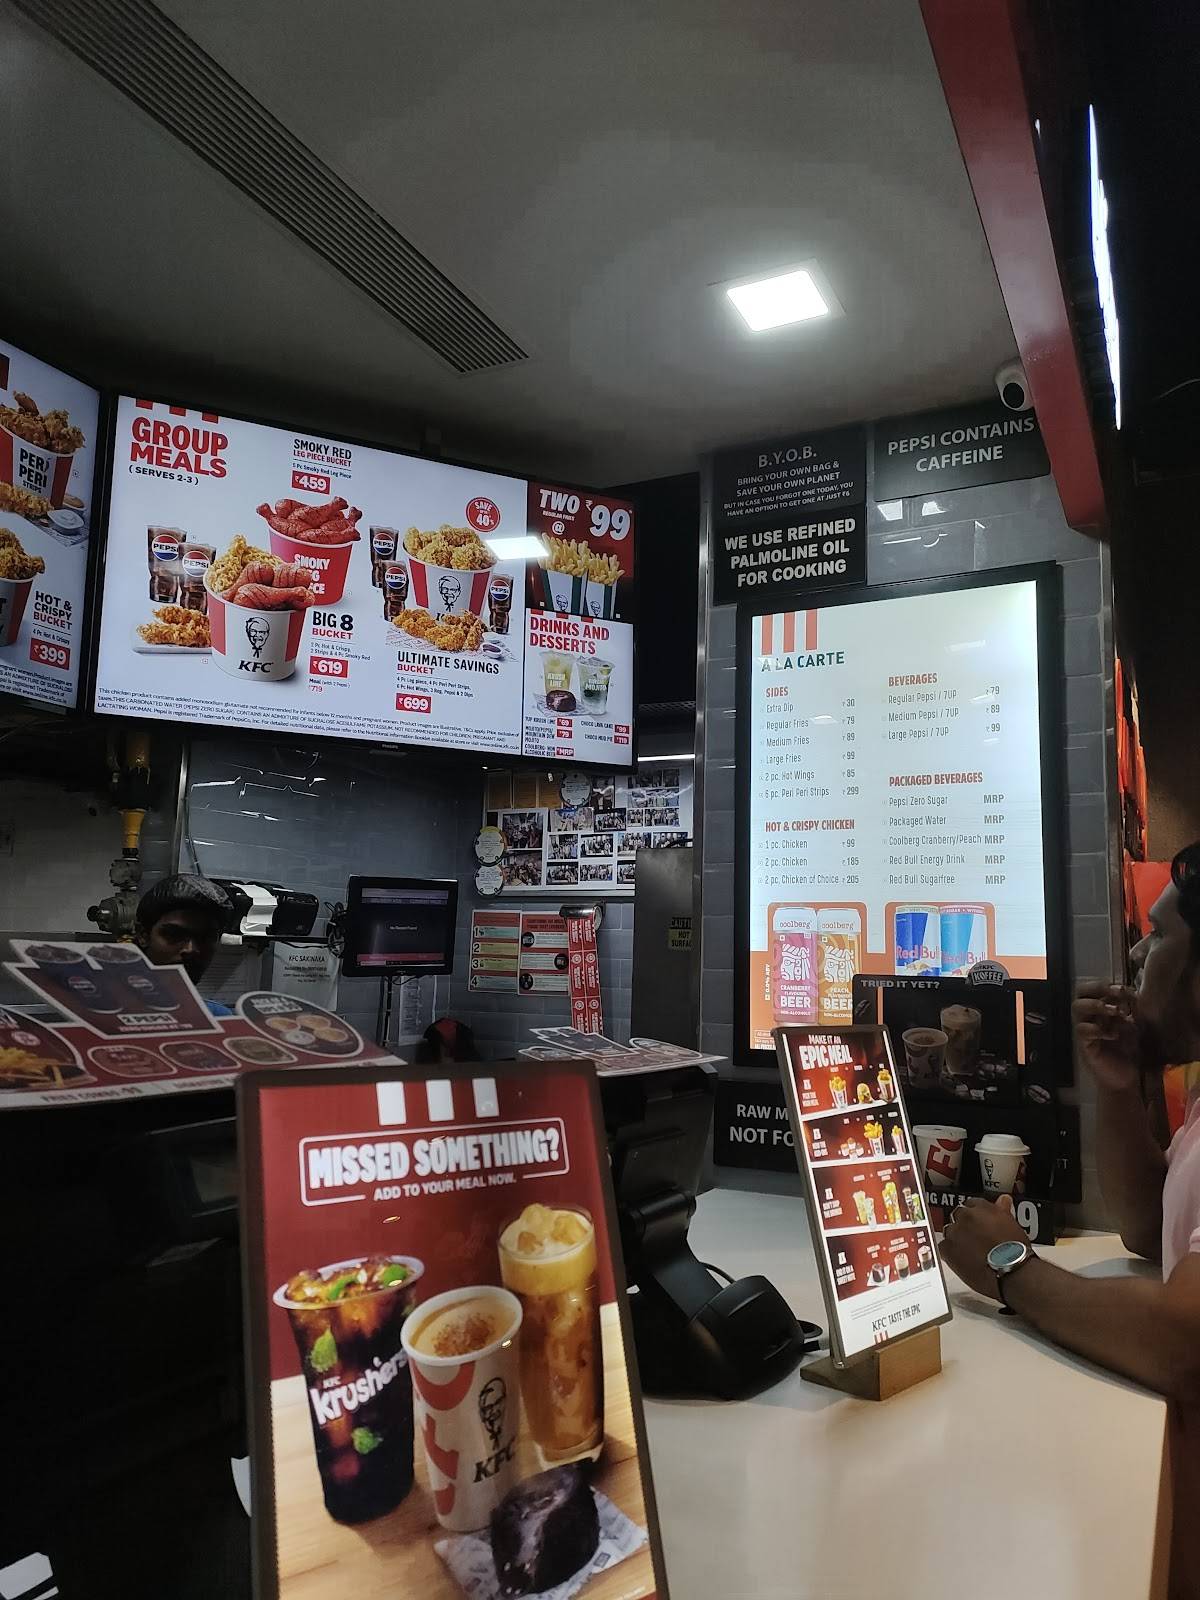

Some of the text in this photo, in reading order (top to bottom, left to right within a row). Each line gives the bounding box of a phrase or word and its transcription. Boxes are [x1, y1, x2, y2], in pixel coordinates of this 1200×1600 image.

[132, 416, 228, 456] GROUP
[888, 417, 1034, 455] PEPSI CONTAINS
[294, 439, 352, 460] SMOKY RED
[758, 446, 817, 468] B.Y.O.B.
[130, 442, 226, 478] MEALS
[294, 450, 352, 467] LEG PIECE BUCKET
[916, 445, 1003, 472] CAFFEINE
[19, 464, 47, 488] PERI
[738, 460, 840, 486] BRING YOUR OWN BAG &
[736, 472, 840, 497] SAVE YOUR OWN PLANET
[776, 492, 801, 502] FORGOT
[840, 482, 854, 490] YOU
[475, 502, 492, 512] SAVE
[540, 488, 580, 514] TWO
[727, 508, 744, 516] HAVE
[755, 504, 778, 512] OPTION
[826, 492, 841, 500] JUST
[552, 520, 565, 535] @
[725, 518, 856, 550] WE USE REFINED
[294, 554, 330, 570] SMOKY
[731, 540, 850, 569] PALMOLINE OIL
[738, 559, 846, 587] FOR COOKING
[36, 591, 72, 611] HOT &
[34, 602, 72, 620] CRISPY
[34, 612, 72, 630] BUCKET
[312, 611, 354, 631] BIG 8
[530, 616, 610, 640] DRINKS AND
[312, 628, 353, 640] BUCKET
[530, 633, 596, 654] DESSERTS
[238, 660, 274, 674] KFC
[398, 650, 500, 674] ULTIMATE SAVINGS
[398, 664, 434, 674] BUCKET
[762, 652, 844, 672] A LA CARTE
[888, 673, 938, 686] BEVERAGES
[766, 686, 788, 698] SIDES
[888, 690, 956, 705] Regular Pepsi 7UP
[766, 702, 794, 713] Extra Dip
[888, 708, 959, 722] Medium Pepsi 7UP
[766, 720, 808, 732] Regular Fries
[766, 736, 810, 747] Medium Fries
[888, 727, 948, 741] Large Pepsi 7UP
[766, 754, 802, 766] Large Fries
[782, 770, 814, 781] Hot Wings
[890, 772, 983, 786] PACKAGED BEVERAGES
[782, 787, 830, 798] Peri Peri Strips
[889, 794, 1004, 808] Pepsi Zero Sugar MRP
[766, 820, 854, 832] HOT & CRISPY CHICKEN
[890, 815, 1004, 827] Packaged Water MRP
[782, 840, 808, 848] Chicken
[890, 834, 1004, 846] Coolberg Cranberry/Peach MRP
[782, 858, 808, 866] Chicken
[890, 854, 1005, 866] Red Bull Energy Drink MRP
[782, 874, 838, 884] Chicken Choice
[890, 874, 1006, 886] Red Bull Sugarfree MRP
[974, 971, 1003, 982] KOFFEE
[861, 980, 893, 988] TRIED
[912, 980, 940, 990] YET?
[780, 996, 810, 1008] BEER
[808, 1034, 842, 1044] MAKE AN
[799, 1045, 853, 1070] EPIC MEAL
[736, 1104, 771, 1119] RAW
[730, 1126, 768, 1144] NOT
[308, 1128, 560, 1189] MISSED SOMETHING?
[374, 1173, 516, 1201] ADD TO YOUR MEAL NOW.
[942, 1194, 955, 1206] AT
[872, 1304, 920, 1332] KFC TASTE THE EPIC
